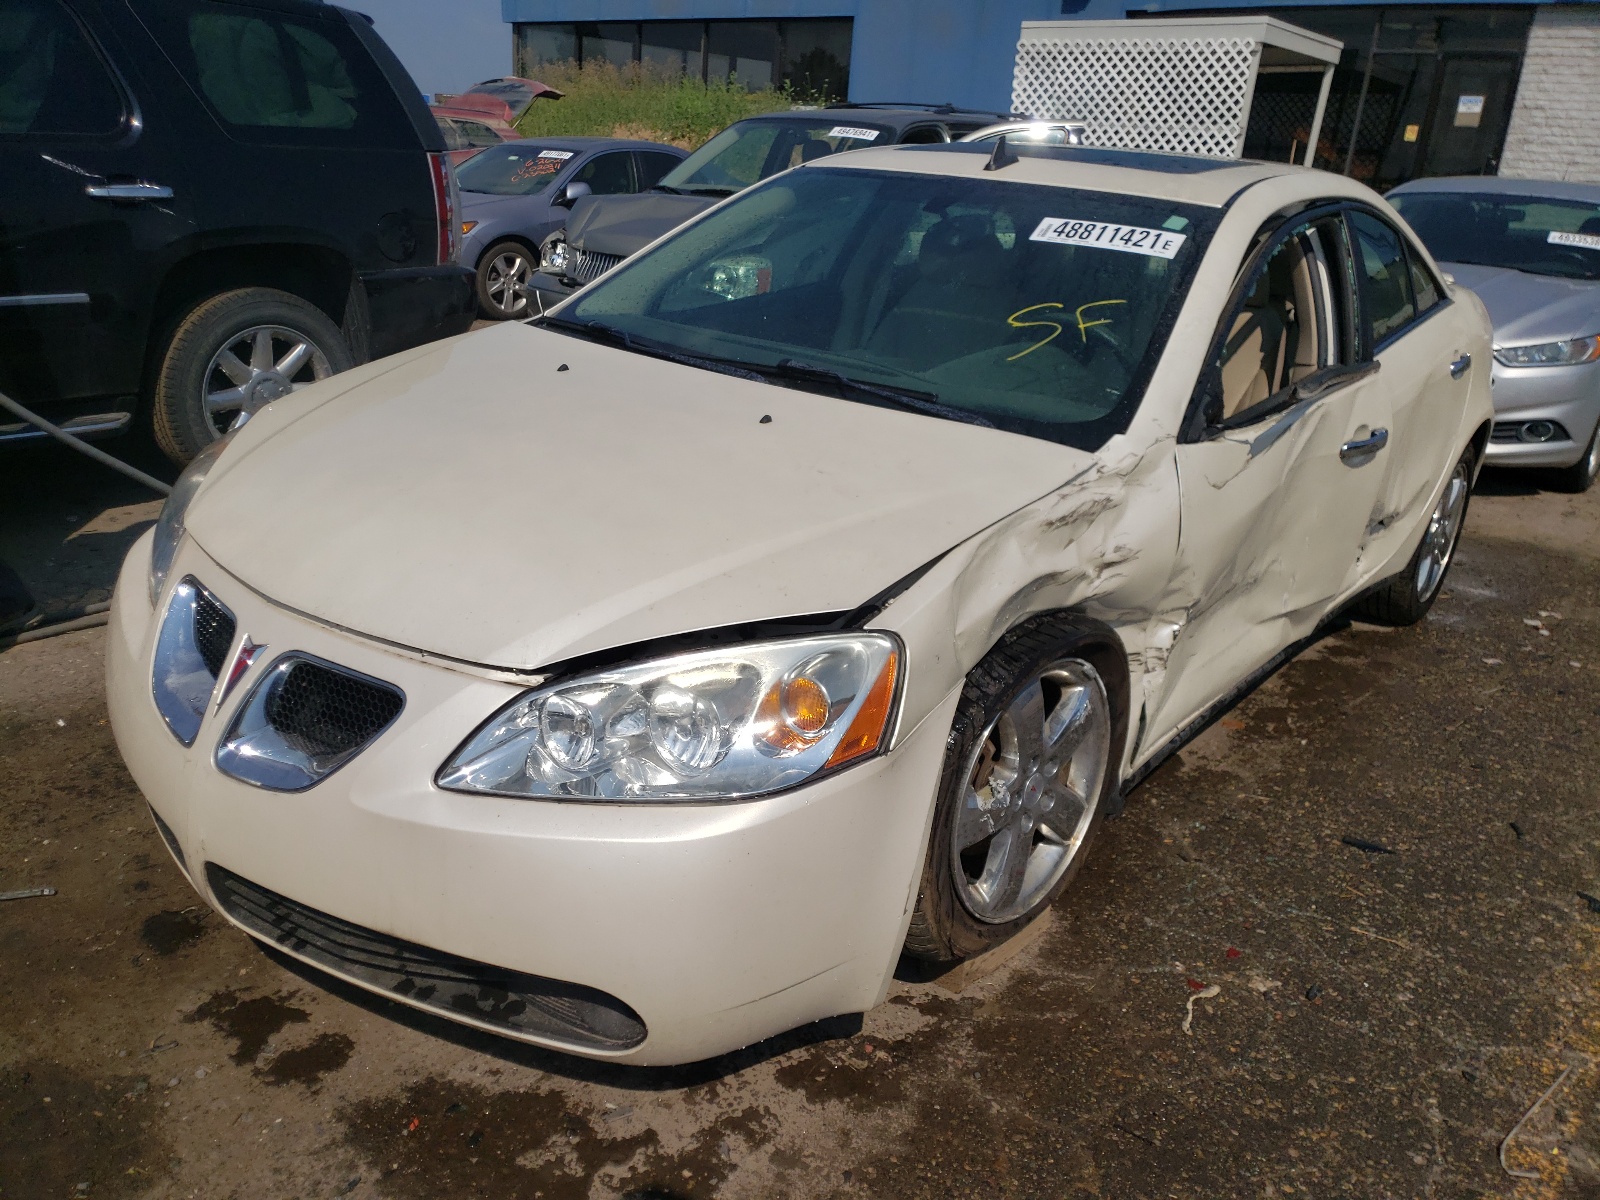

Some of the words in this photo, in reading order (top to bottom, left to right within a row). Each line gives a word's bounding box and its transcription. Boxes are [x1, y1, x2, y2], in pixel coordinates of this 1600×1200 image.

[1053, 220, 1163, 250] 48811421
[1163, 240, 1174, 251] E
[1006, 299, 1128, 361] SF
